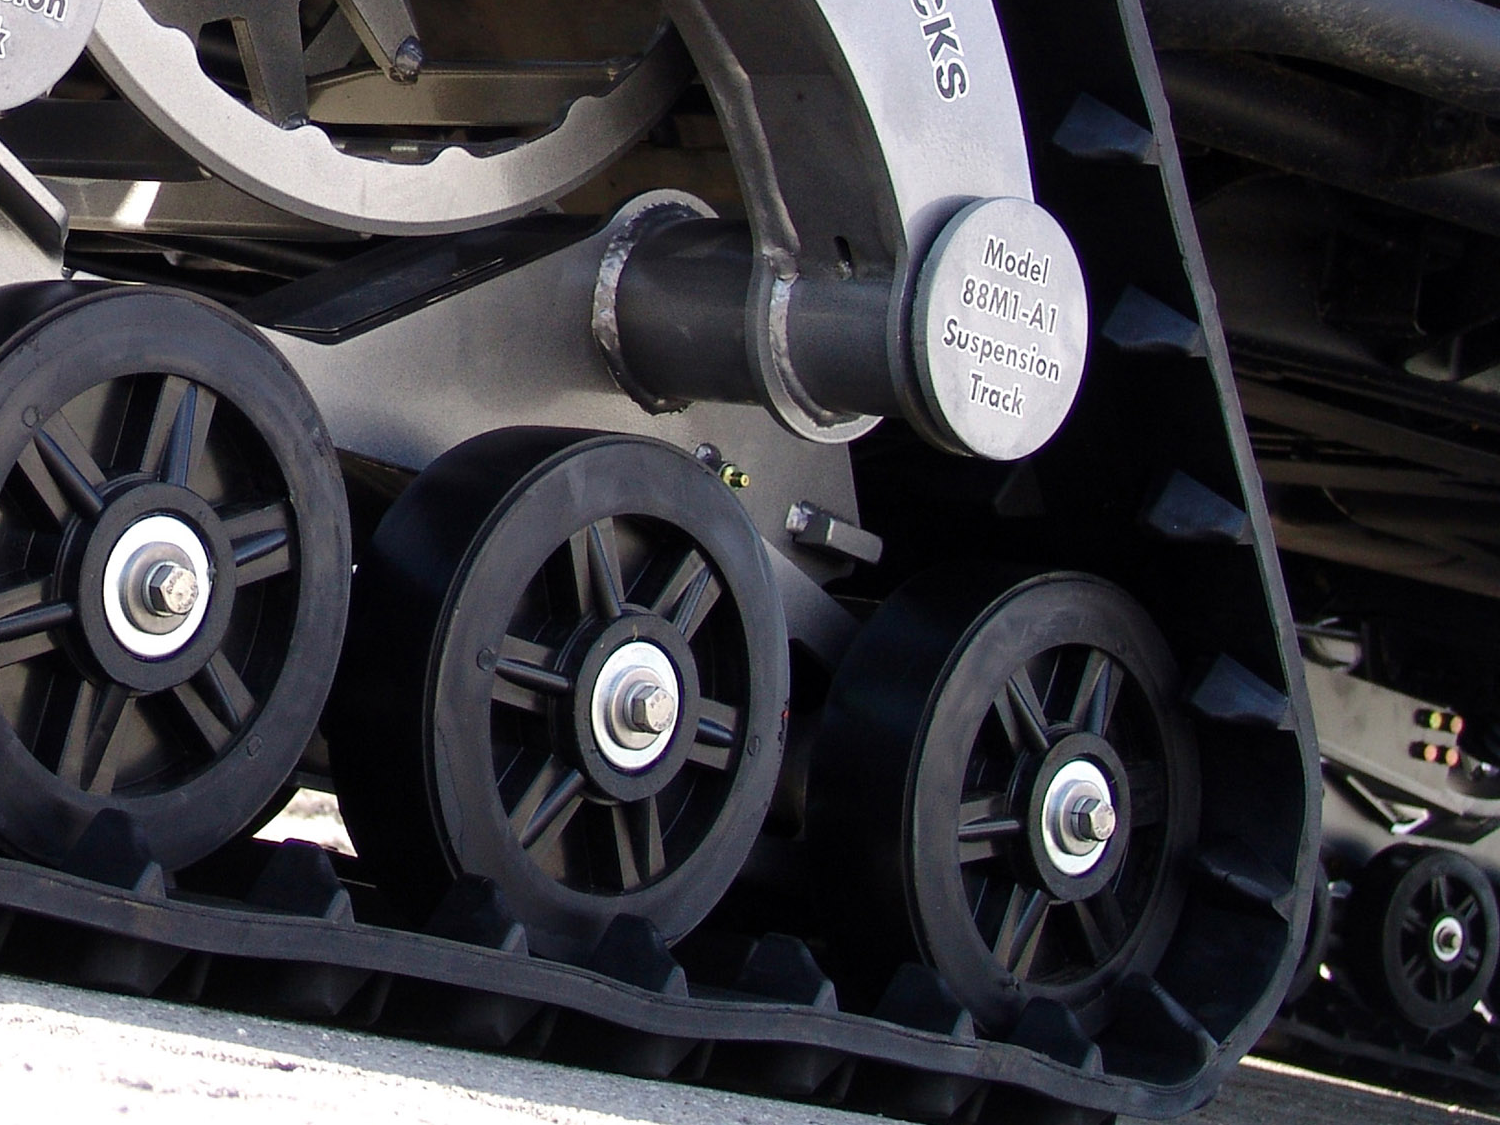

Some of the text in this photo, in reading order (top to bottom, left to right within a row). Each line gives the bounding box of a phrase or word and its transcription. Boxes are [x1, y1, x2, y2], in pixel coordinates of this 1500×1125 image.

[983, 237, 1050, 284] Model
[962, 277, 1058, 334] 88M1-A1
[943, 317, 1061, 382] Suspension
[969, 372, 1025, 416] Track
